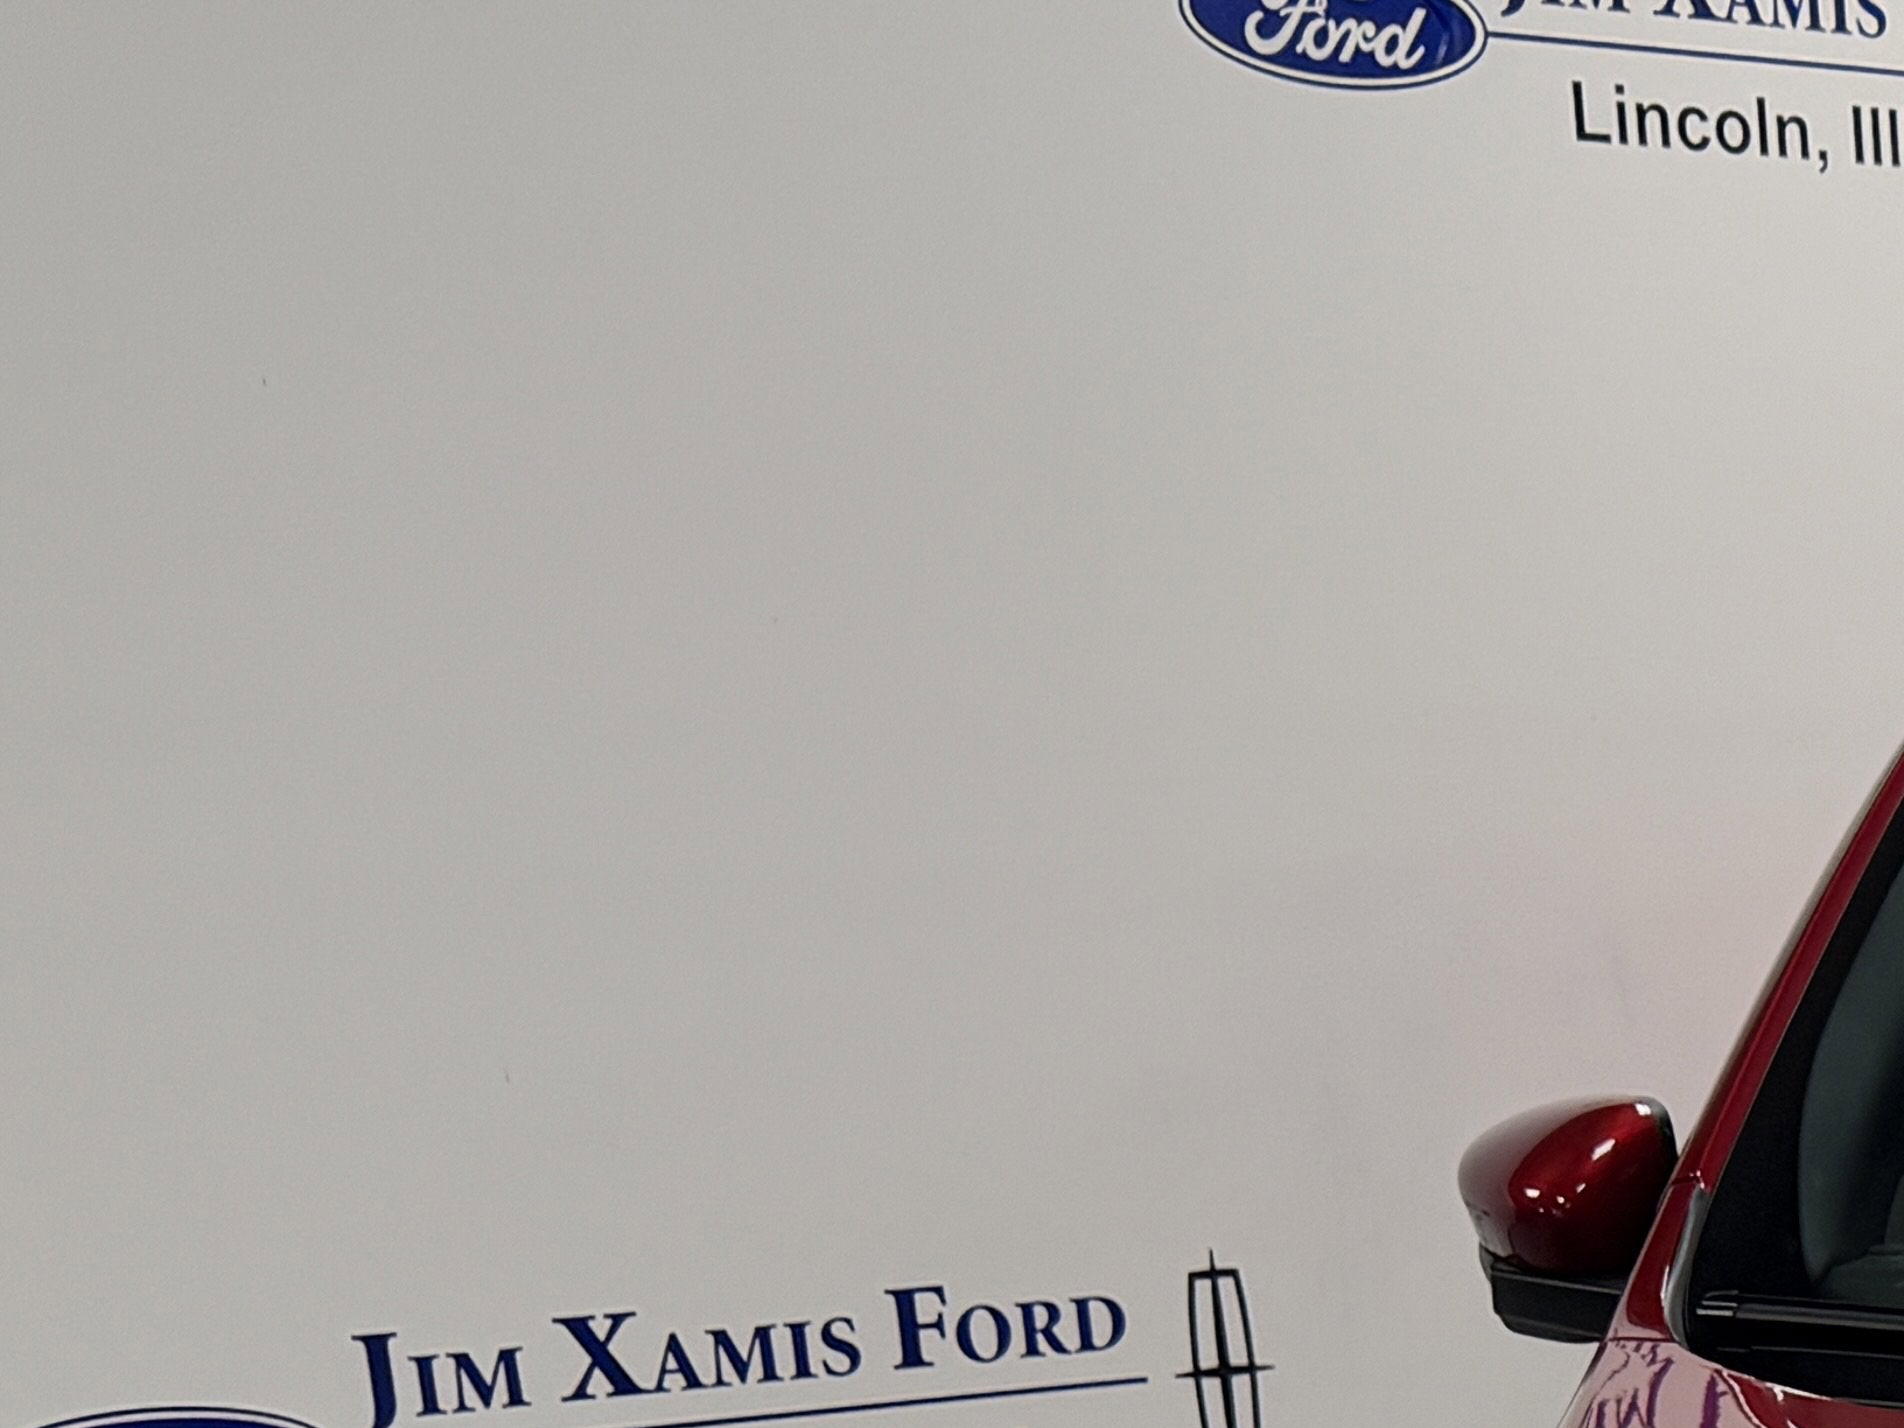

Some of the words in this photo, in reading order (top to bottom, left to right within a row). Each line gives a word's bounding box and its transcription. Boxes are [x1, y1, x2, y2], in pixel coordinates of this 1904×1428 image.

[1244, 0, 1427, 69] Ford
[1572, 81, 1828, 173] Lincoln,
[552, 1311, 862, 1402] XAMIS
[885, 1285, 1127, 1370] FORD
